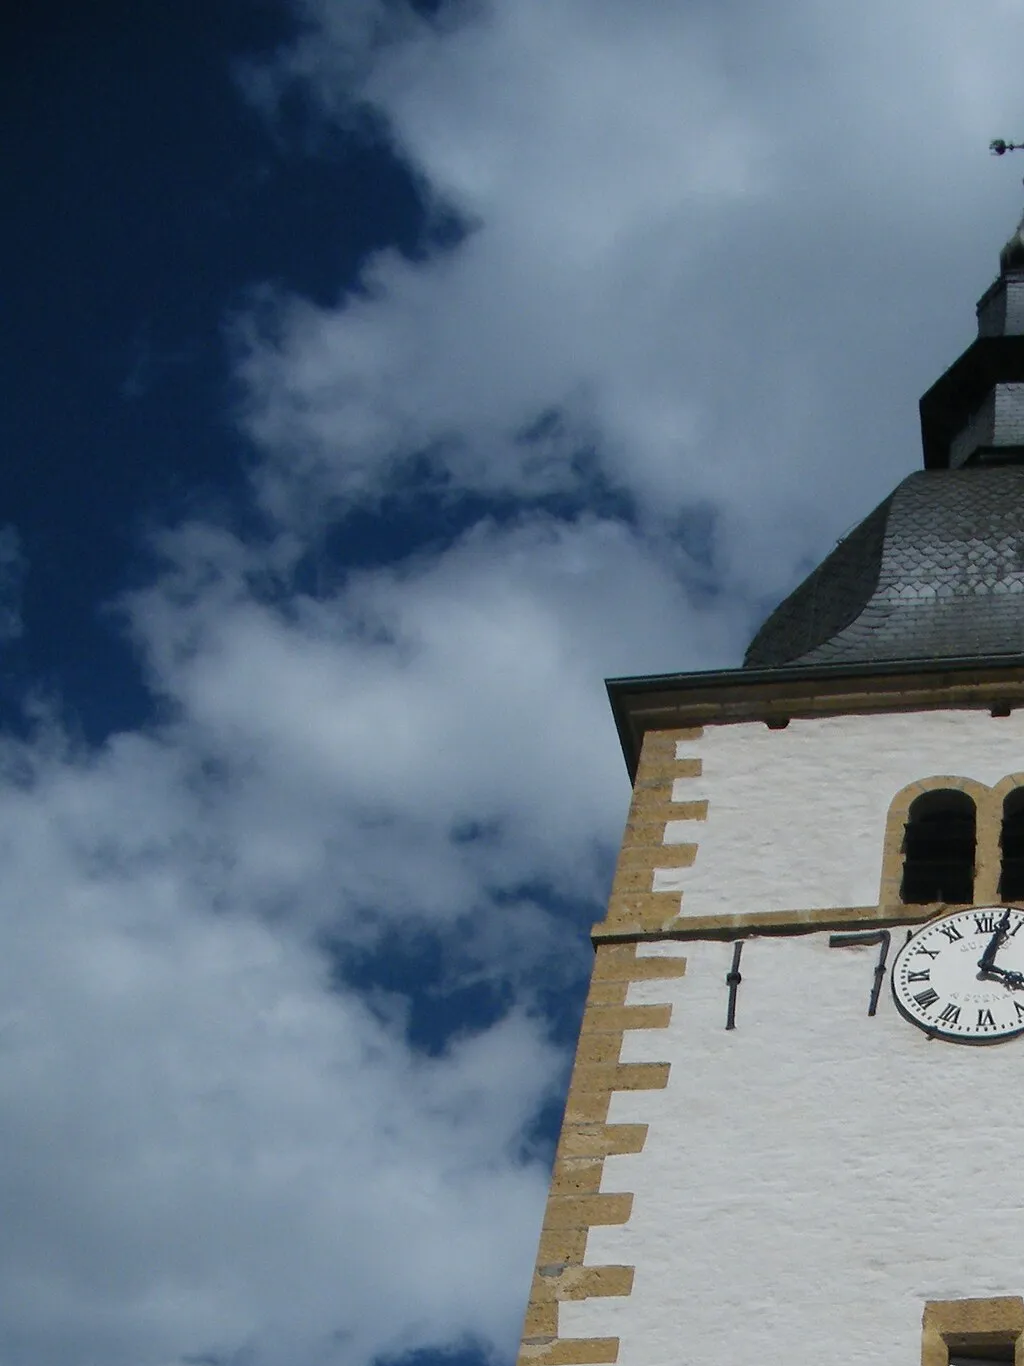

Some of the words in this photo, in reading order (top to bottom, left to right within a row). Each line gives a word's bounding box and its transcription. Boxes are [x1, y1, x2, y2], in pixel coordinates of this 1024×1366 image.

[939, 925, 964, 944] XI
[1009, 921, 1024, 937] I
[916, 945, 940, 960] X
[908, 968, 930, 983] IX
[913, 987, 940, 1010] VIII
[938, 1002, 962, 1024] VII
[976, 1008, 995, 1026] VI
